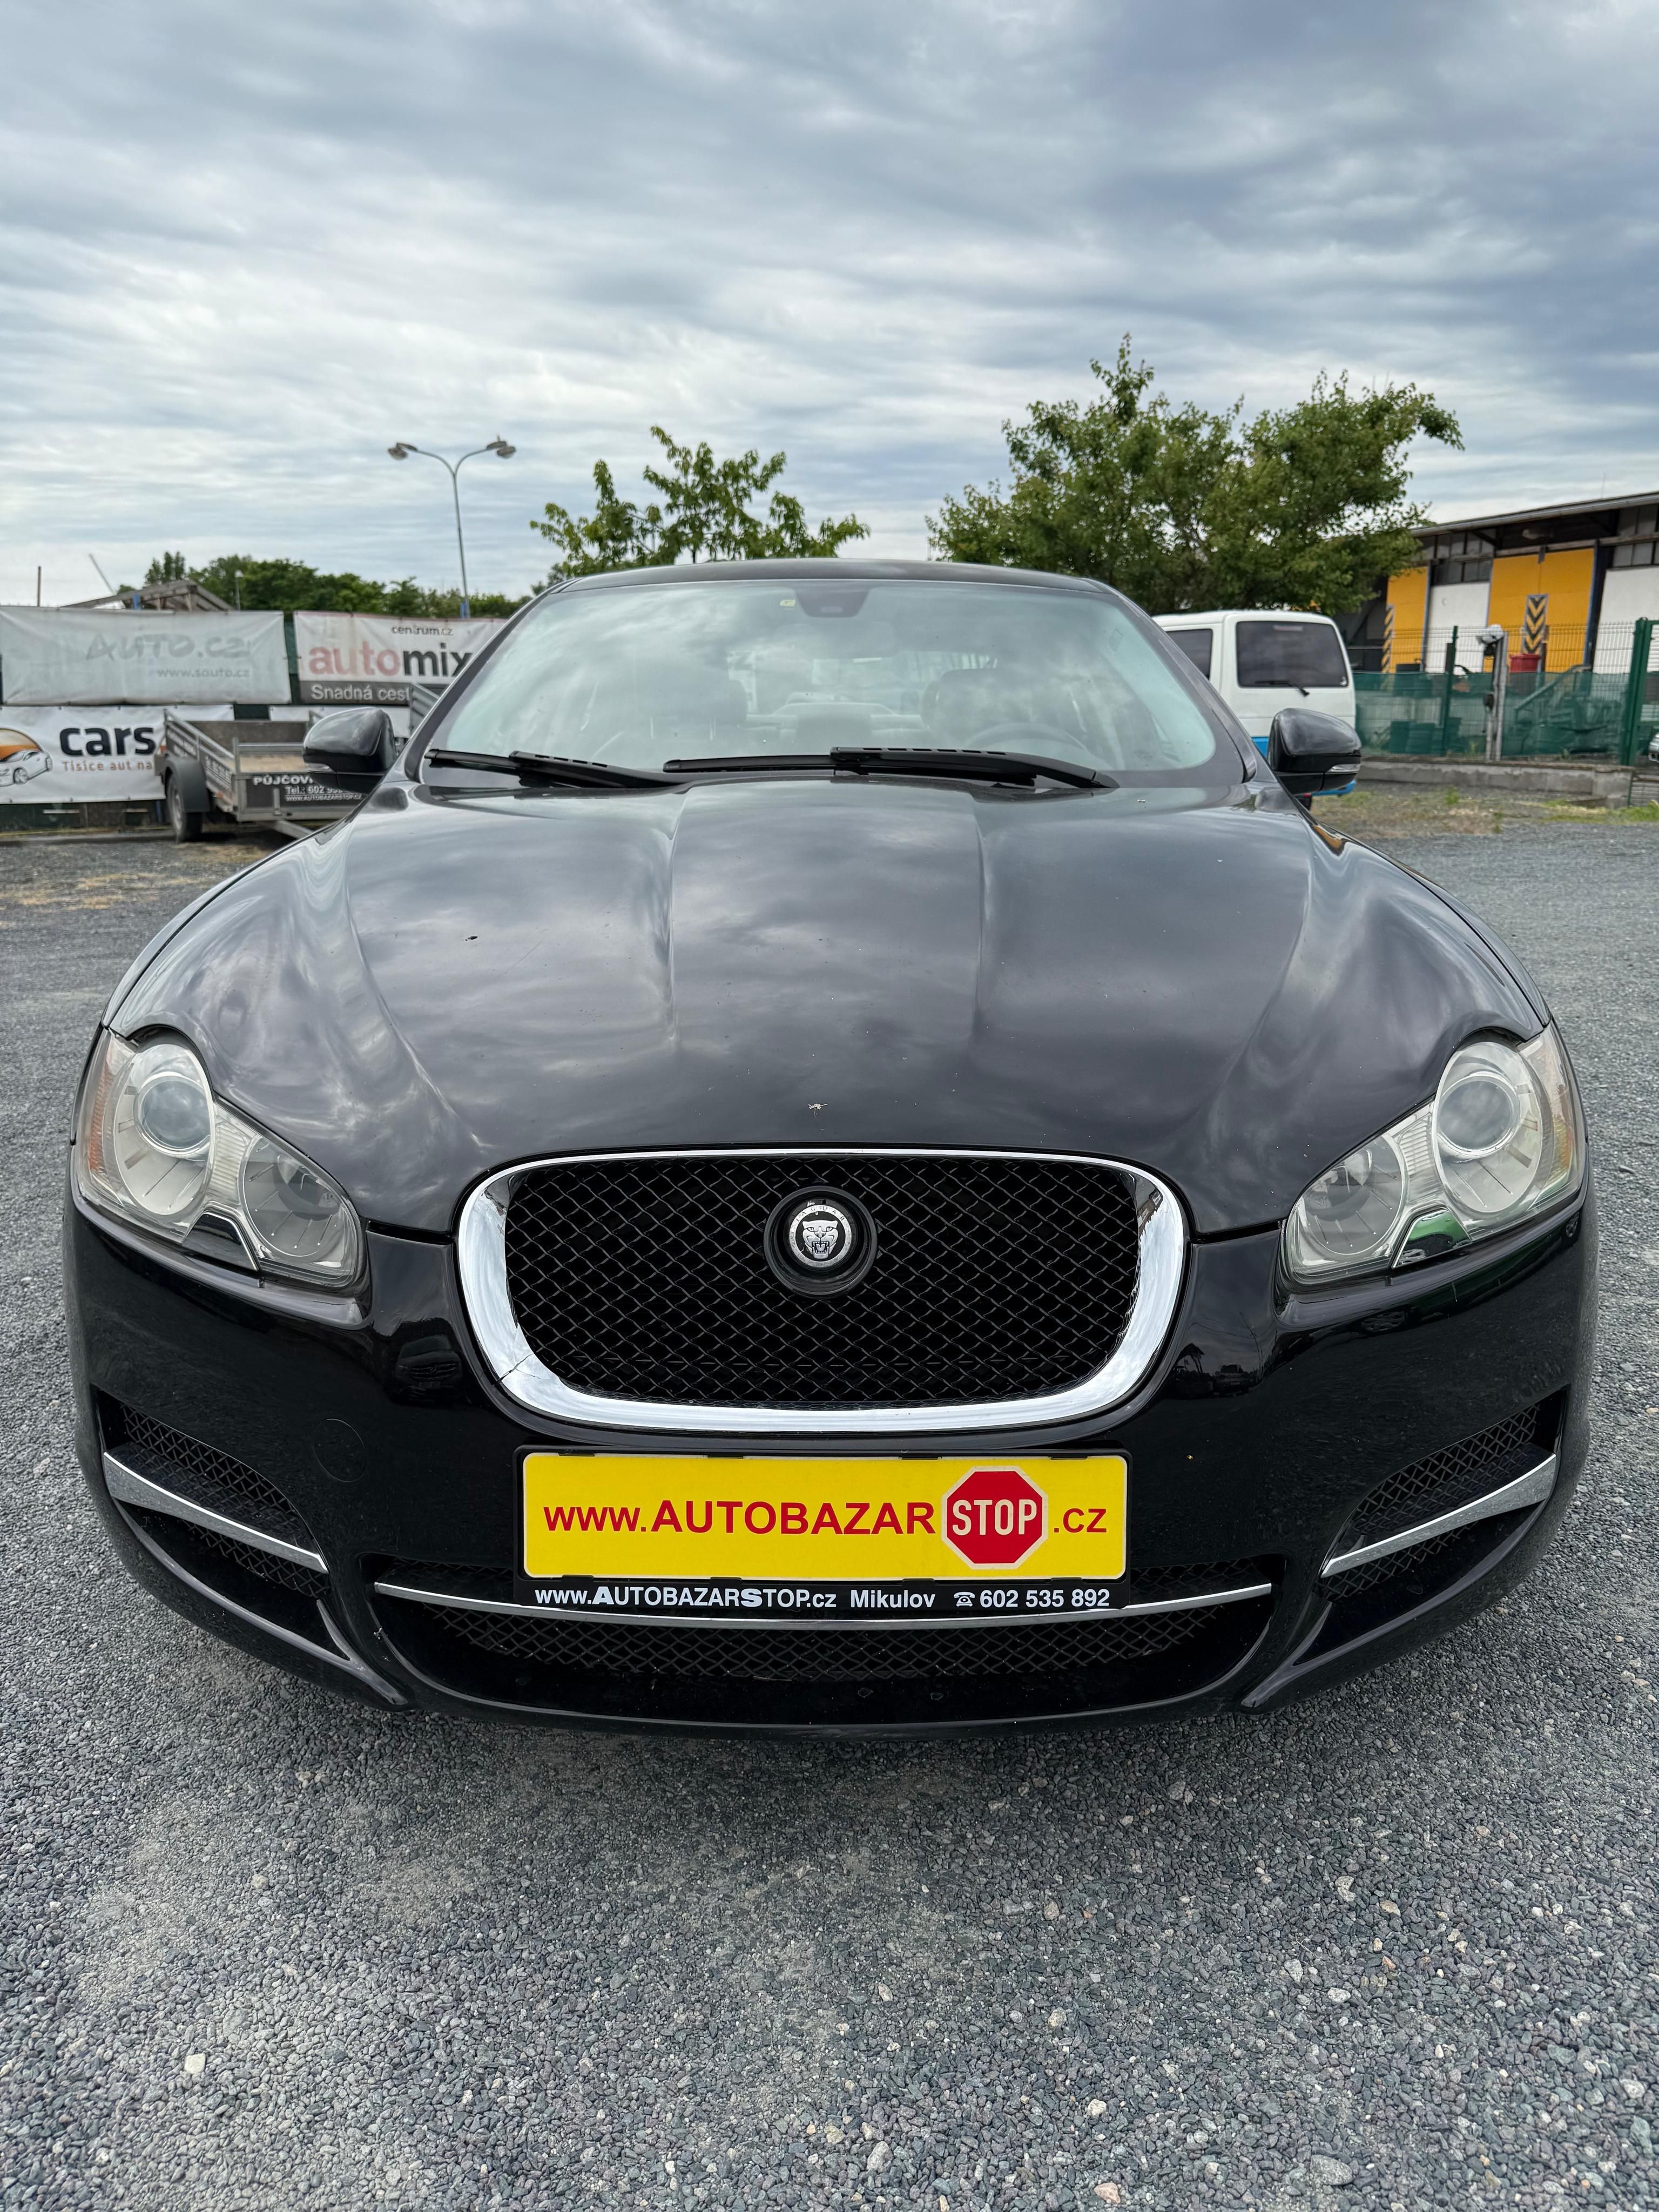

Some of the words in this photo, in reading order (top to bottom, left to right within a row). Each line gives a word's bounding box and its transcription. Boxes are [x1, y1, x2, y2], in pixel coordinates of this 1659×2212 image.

[392, 625, 454, 636] centrum.cz
[158, 667, 250, 678] www.sauto.cz
[311, 684, 373, 700] Snadná
[60, 727, 156, 756] cars
[110, 760, 131, 771] aut
[137, 760, 153, 770] na
[795, 1206, 845, 1222] JAGUAR
[952, 1499, 1037, 1536] STOP
[851, 1589, 936, 1608] Mikulov
[980, 1589, 1019, 1608] 602
[1026, 1589, 1064, 1608] 535
[1071, 1588, 1110, 1607] 892
